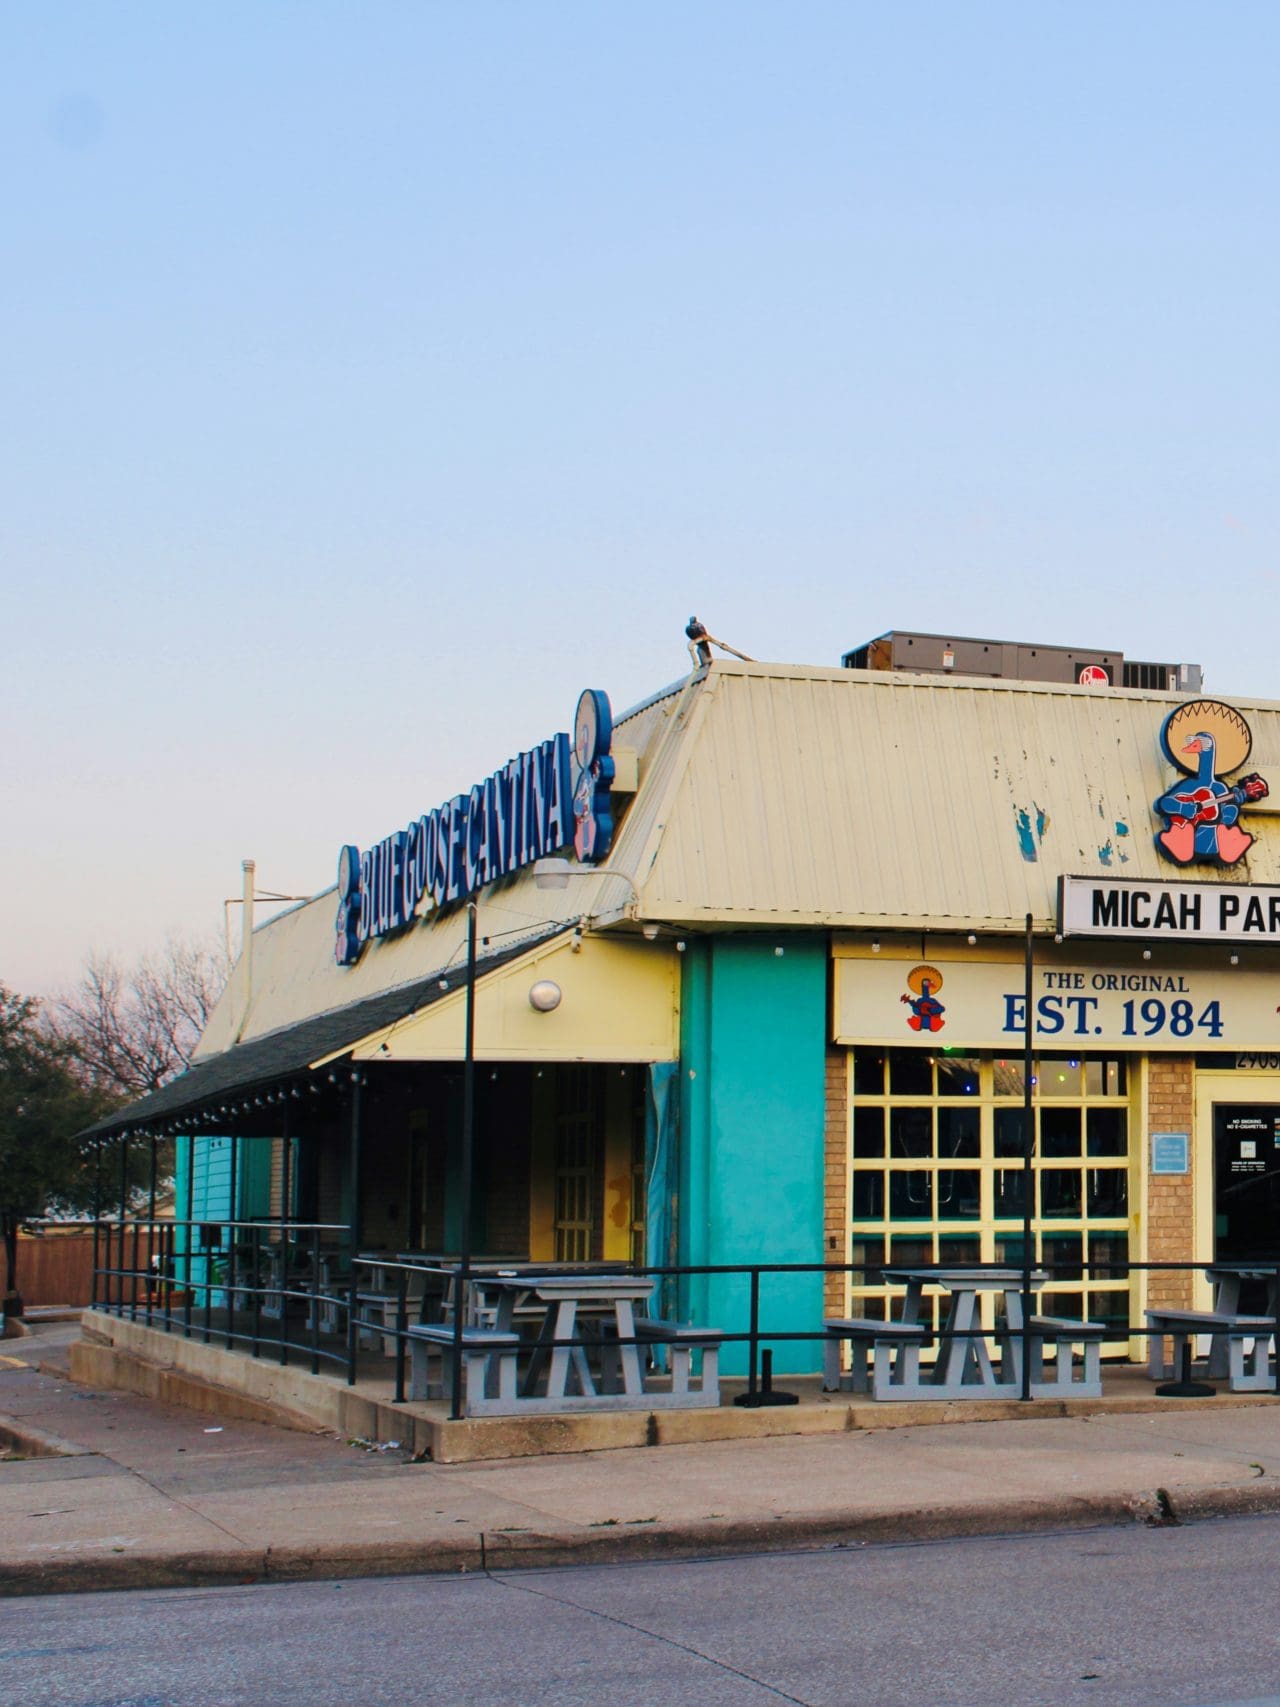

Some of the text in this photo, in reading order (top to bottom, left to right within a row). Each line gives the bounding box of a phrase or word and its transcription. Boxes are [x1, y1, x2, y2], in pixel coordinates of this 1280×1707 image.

[359, 733, 570, 942] BLUE GOOSE CANTINA
[1091, 889, 1201, 930] MICAH
[1043, 972, 1190, 992] THE ORIGINAL
[1002, 994, 1225, 1037] EST. 1984
[1237, 1053, 1279, 1069] 2905
